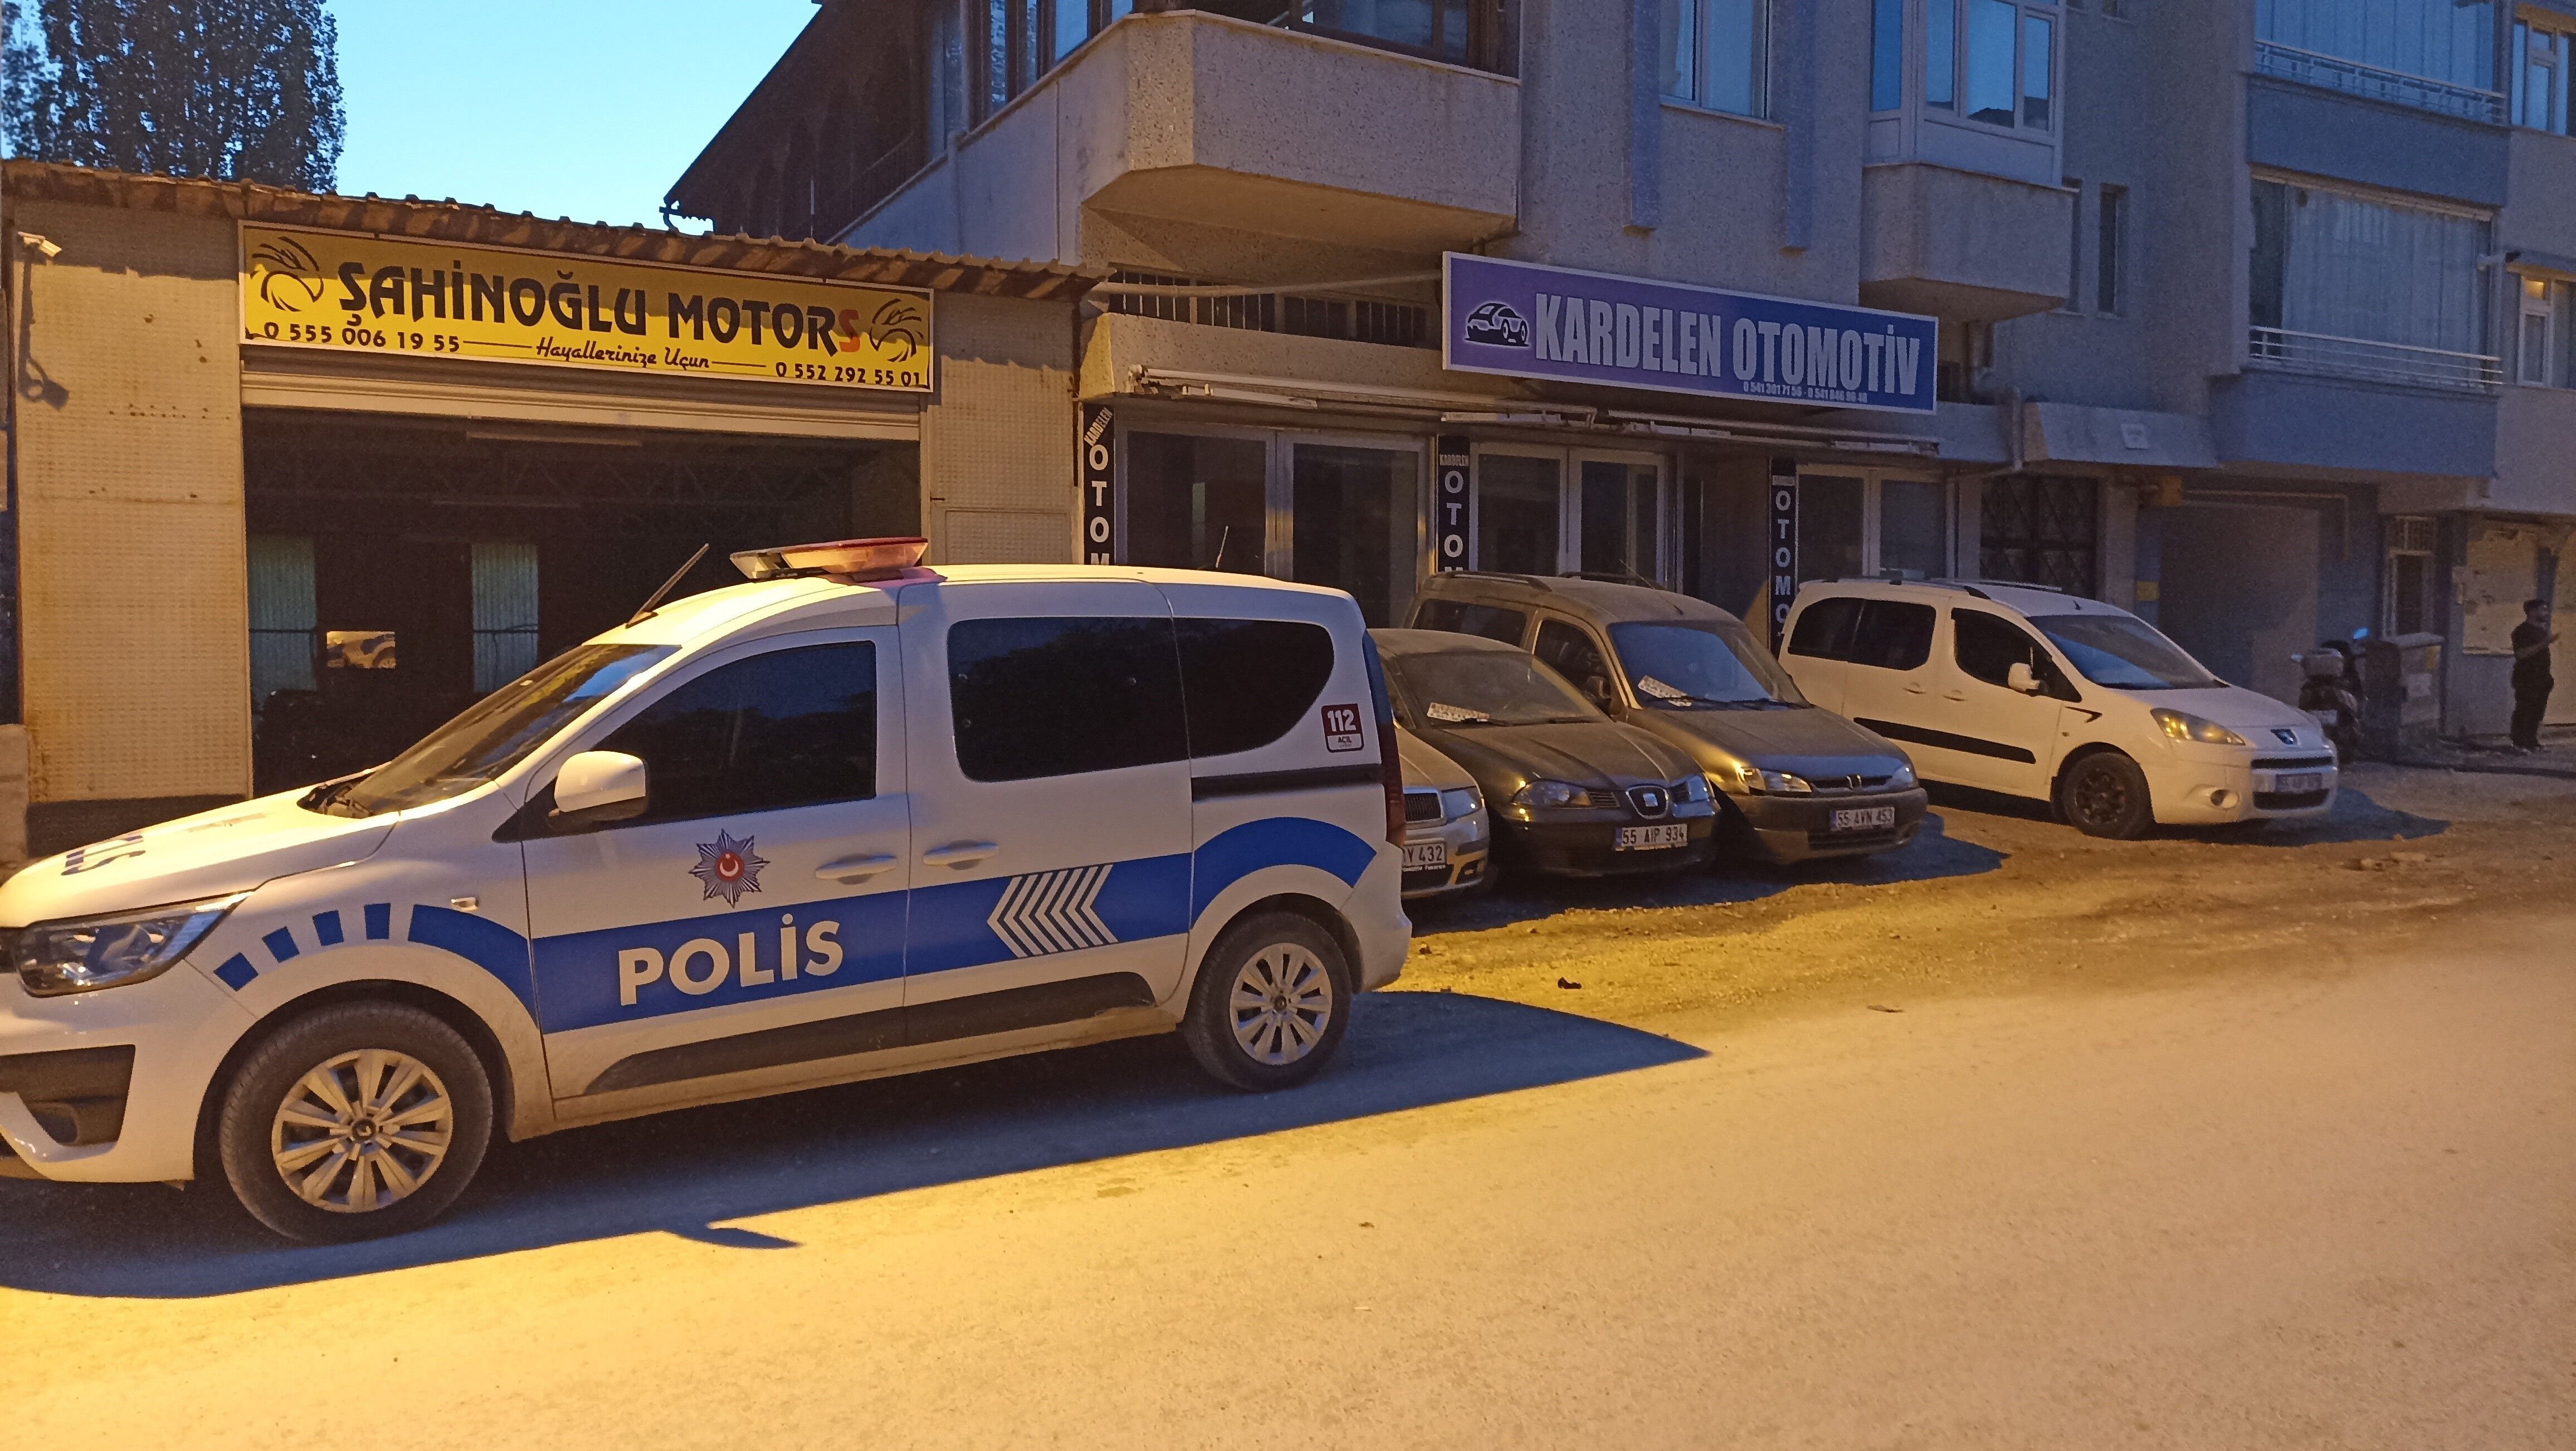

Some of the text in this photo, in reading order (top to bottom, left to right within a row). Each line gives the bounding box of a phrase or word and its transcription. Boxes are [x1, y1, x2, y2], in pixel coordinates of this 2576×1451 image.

[338, 259, 861, 357] ŞAHİNOĞLU MOTORS
[264, 322, 460, 352] 0 555 006 19 55
[536, 336, 710, 371] Hayallerinize Uçun
[1535, 293, 1921, 396] KARDELEN OTOMOTİV
[775, 362, 920, 387] 0 552 292 55 01
[1084, 407, 1114, 446] KARDELEN
[1444, 470, 1464, 572] OTO
[1775, 490, 1791, 636] OTOMO
[1327, 709, 1357, 732] 112
[1418, 844, 1443, 863] 432
[1622, 826, 1684, 845] 55 AIP 934
[618, 913, 843, 1006] POLİS
